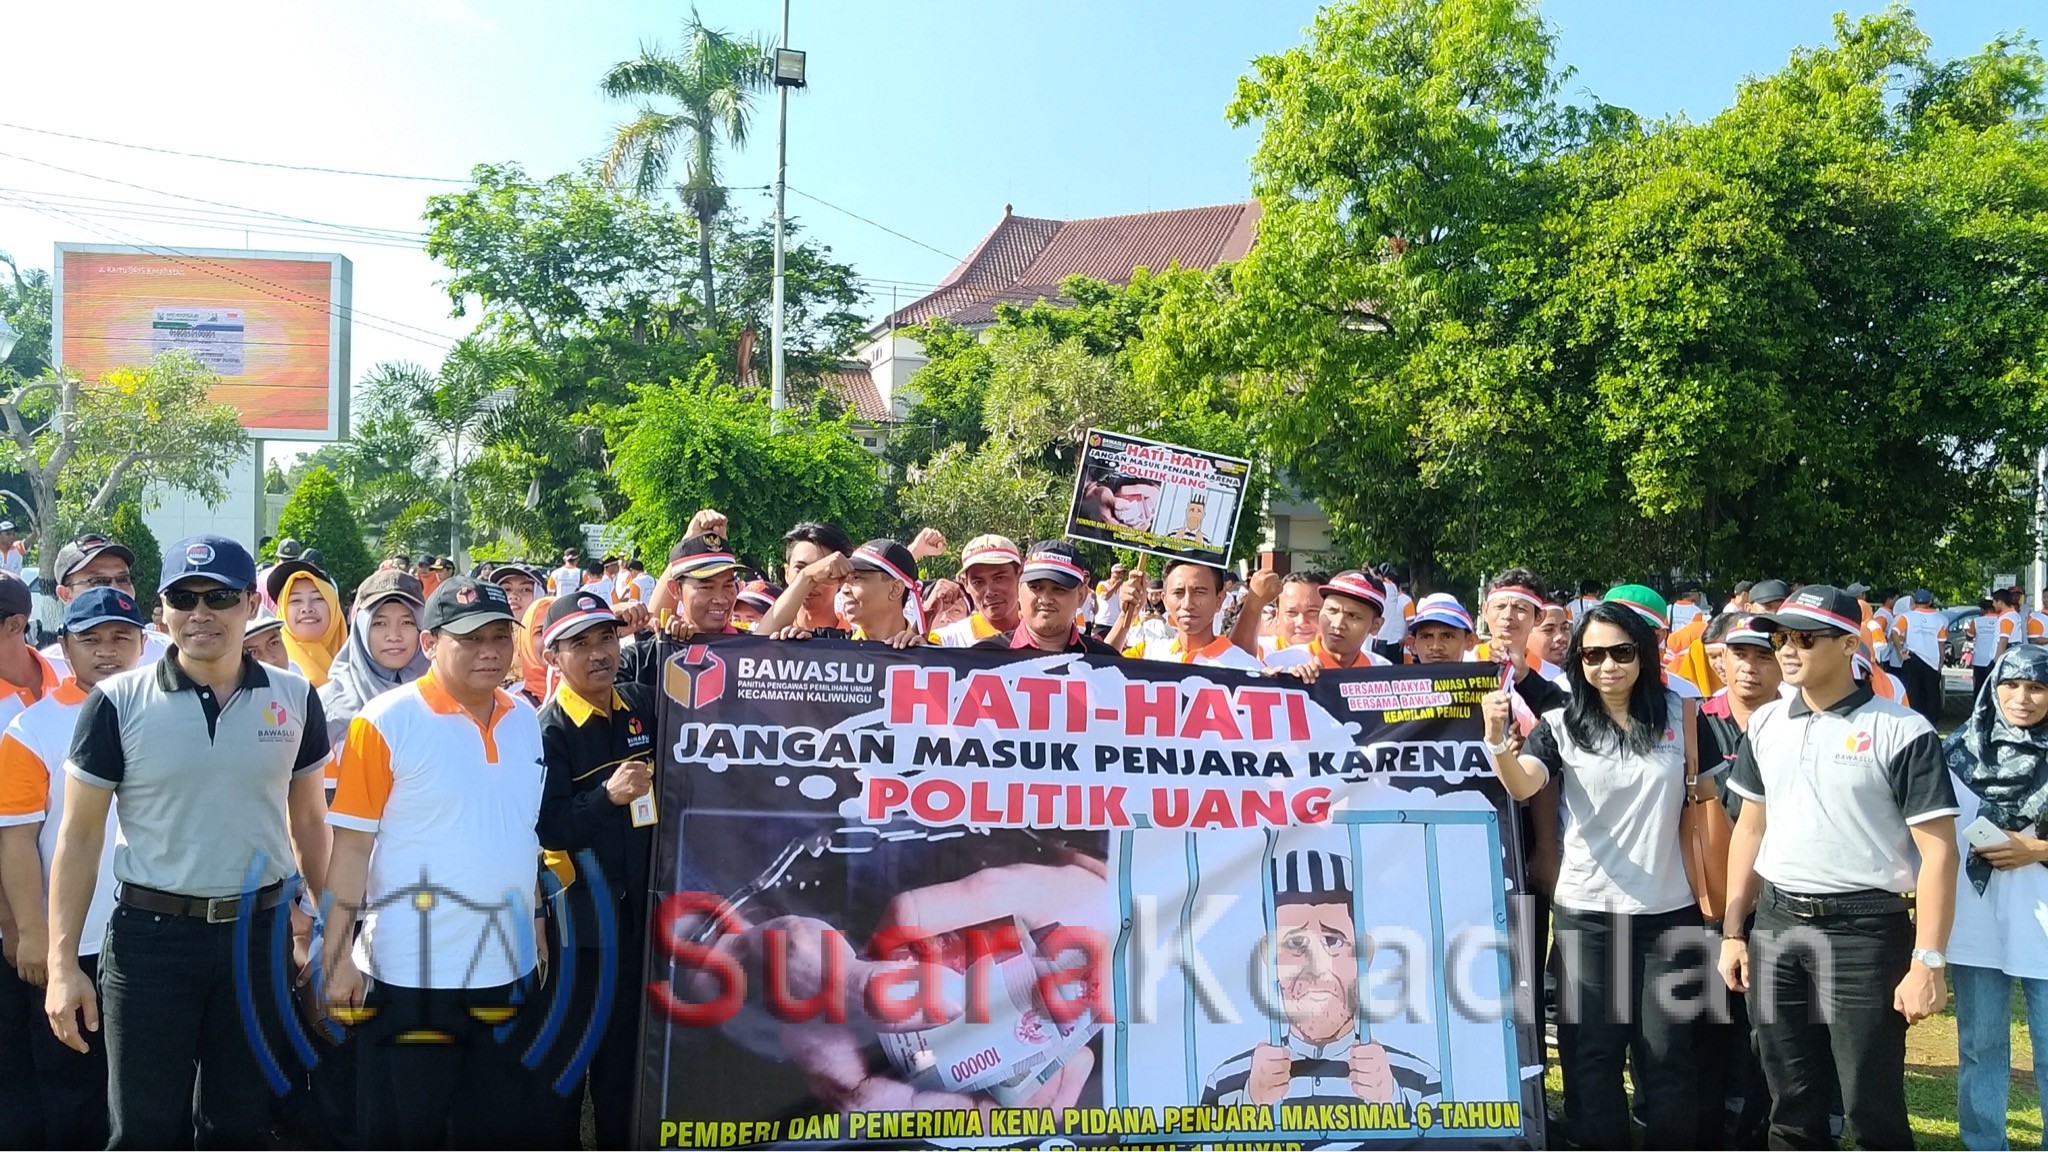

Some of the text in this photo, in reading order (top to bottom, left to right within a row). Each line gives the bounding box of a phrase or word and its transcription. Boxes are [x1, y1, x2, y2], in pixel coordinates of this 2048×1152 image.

[1091, 450, 1239, 486] JANGAN MASUK PENJARA KARENA
[1127, 444, 1208, 470] HATI-HATI
[1120, 464, 1206, 489] POLITIK UANG
[738, 658, 875, 683] BAWASLU
[737, 680, 766, 688] PANITIA
[767, 681, 808, 690] PENGAWAS
[809, 683, 849, 692] PEMILIHAN
[737, 688, 872, 704] KECAMATAN KALIWUNGU
[1341, 683, 1390, 695] BERSAMA
[1393, 680, 1430, 692] RAKYAT
[1433, 681, 1466, 692] AWASI
[890, 670, 1310, 741] HATI-HATI
[1350, 697, 1398, 709] BERSAMA
[1401, 693, 1450, 706] BAWASLU
[1384, 707, 1470, 723] KEADILAN PEMILU
[680, 729, 1492, 778] JANGAN MASUK PENJARA KARENA
[1835, 754, 1873, 763] BAWASLU
[867, 777, 1332, 828] POLITIK UANG
[951, 1046, 1001, 1083] 100000
[660, 1102, 1520, 1147] PEMBERI DAN PENERIMA KENA PIDANA PENJARA MAKSIMAL 6 TAHUN
